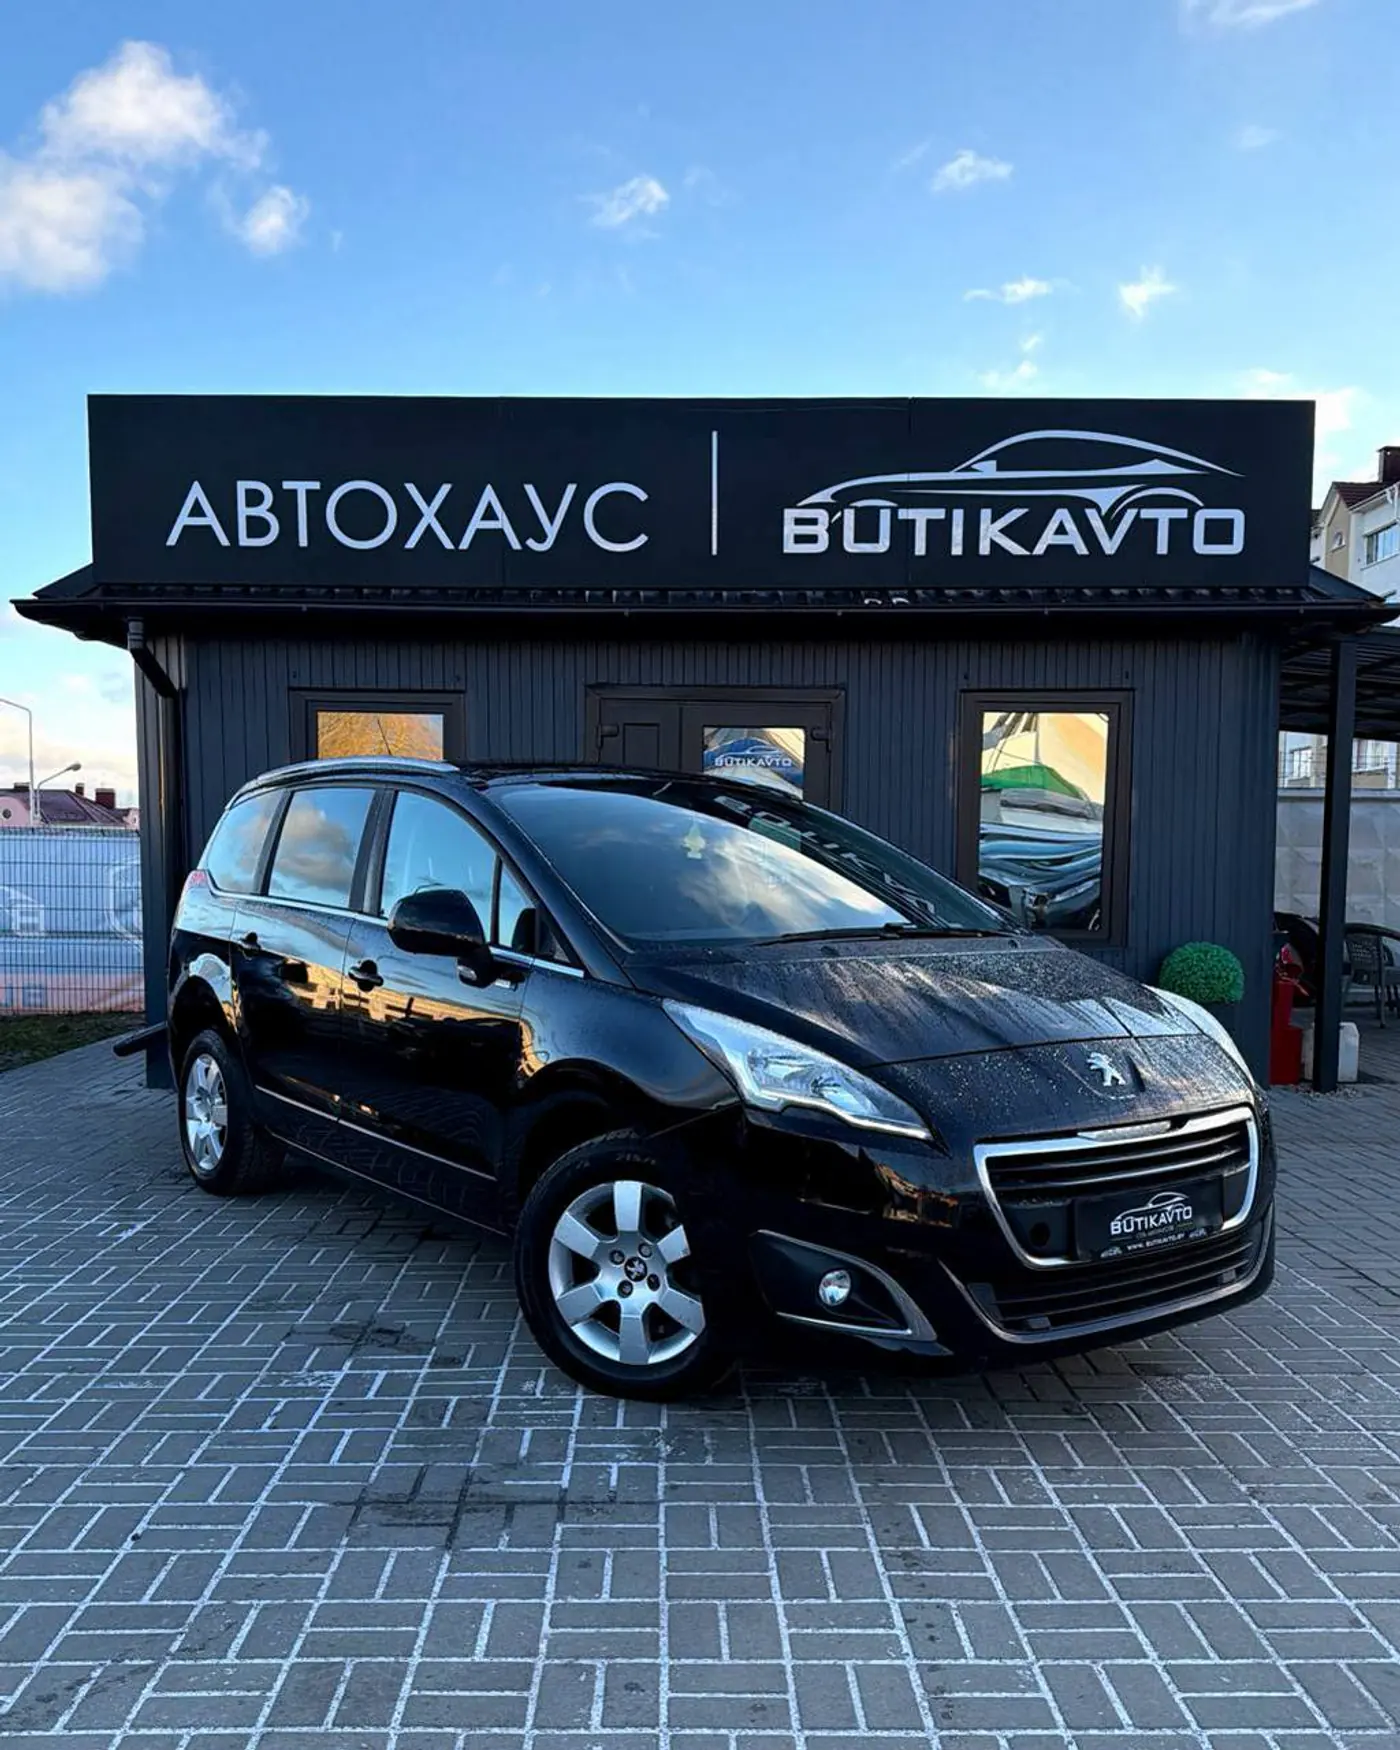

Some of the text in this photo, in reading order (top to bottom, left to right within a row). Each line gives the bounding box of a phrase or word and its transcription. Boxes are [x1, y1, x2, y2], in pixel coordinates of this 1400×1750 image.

[165, 480, 649, 553] АВТОХАУС
[783, 507, 1245, 556] BUTIKAVTO
[1110, 1206, 1192, 1235] BUTIKAVTO
